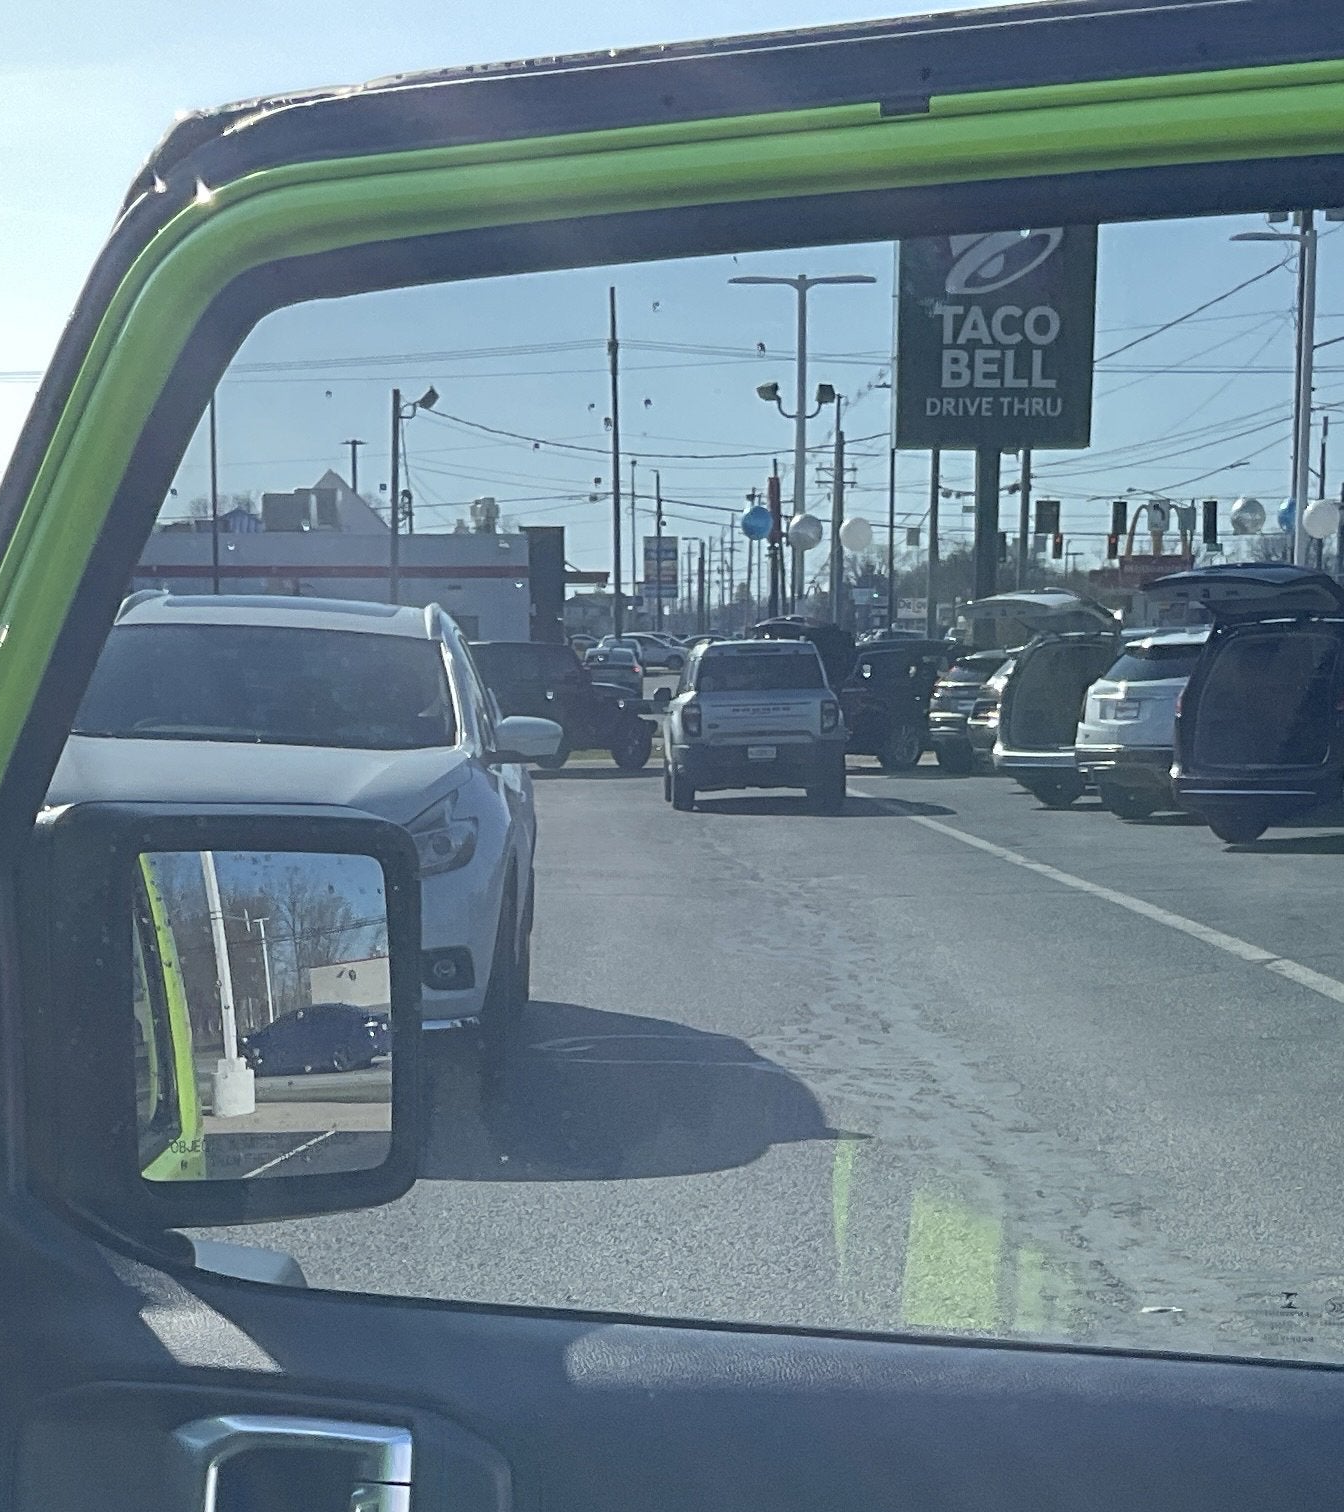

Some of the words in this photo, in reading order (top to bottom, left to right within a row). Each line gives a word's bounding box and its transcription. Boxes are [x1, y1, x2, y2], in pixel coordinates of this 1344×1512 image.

[937, 305, 1060, 346] TACO
[940, 349, 1057, 388] BELL
[925, 397, 993, 417] DRIVE
[1000, 397, 1063, 417] THRU
